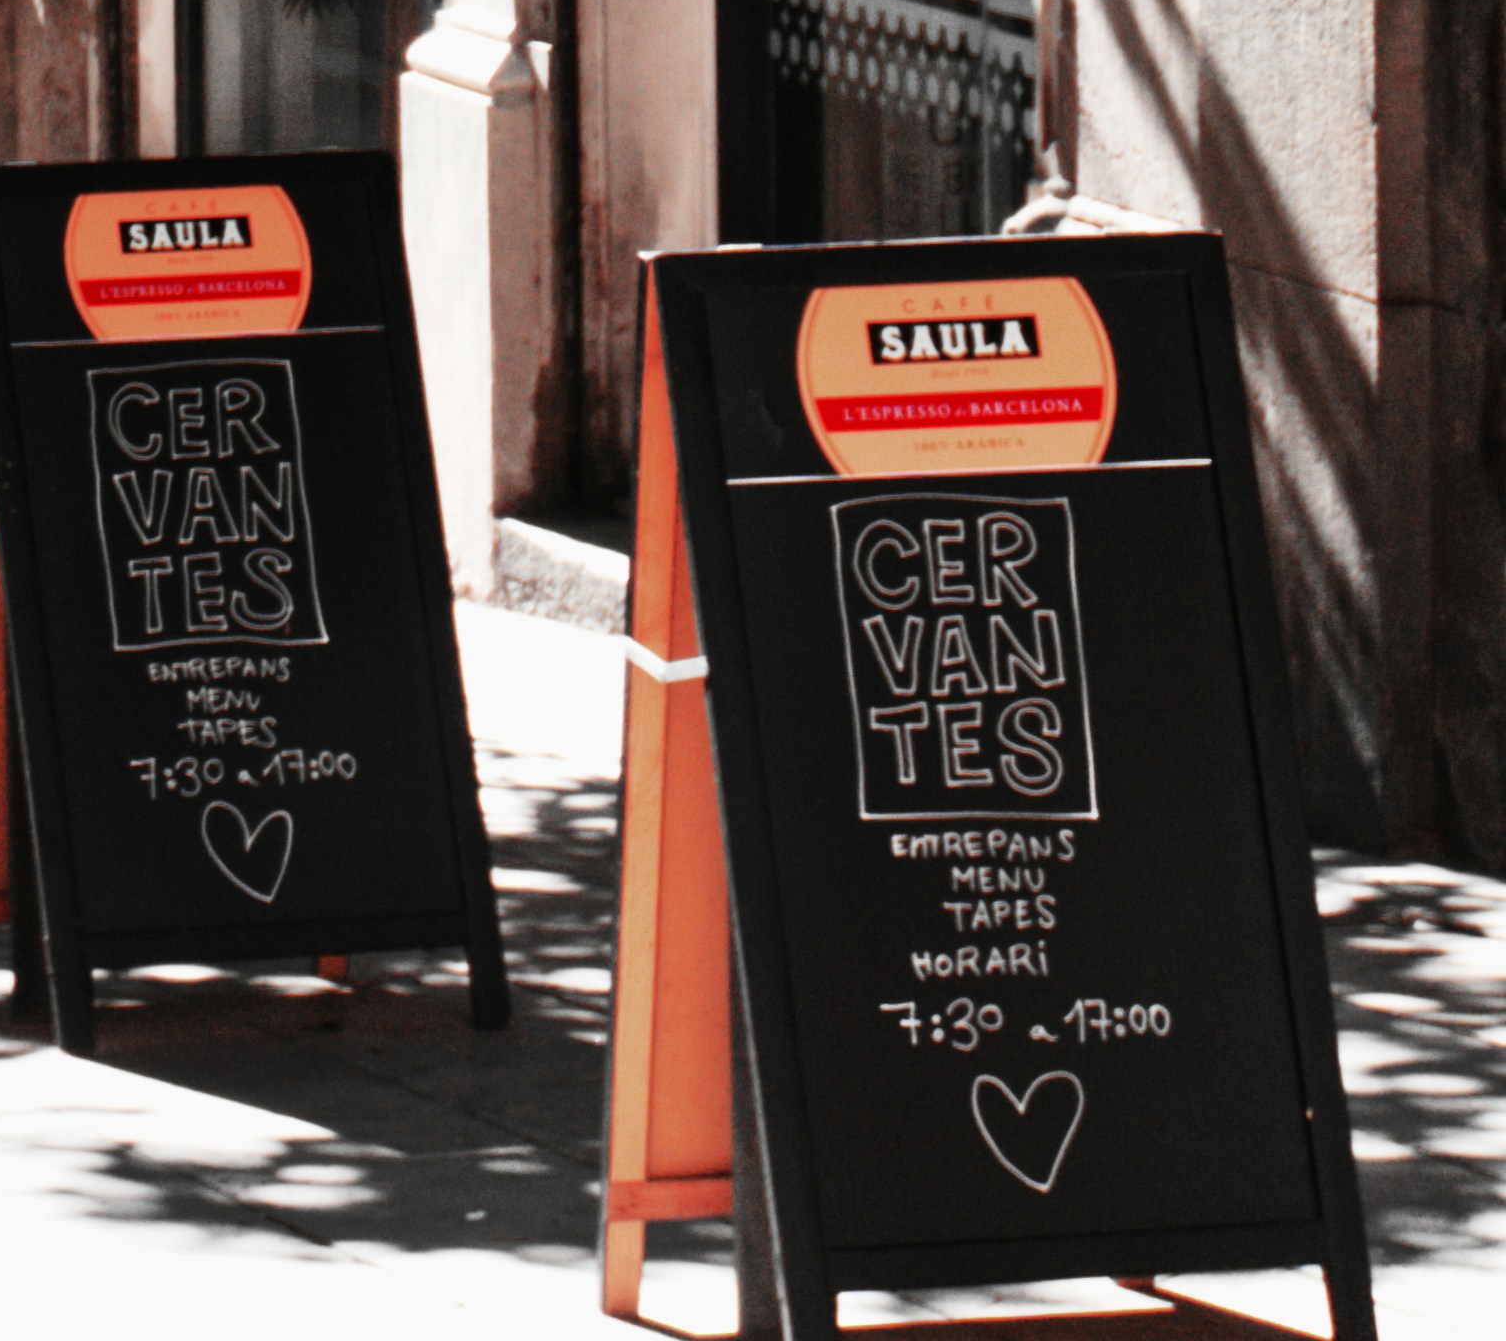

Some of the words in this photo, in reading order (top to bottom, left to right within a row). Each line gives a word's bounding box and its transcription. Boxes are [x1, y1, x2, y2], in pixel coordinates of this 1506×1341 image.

[130, 219, 244, 251] SAULA
[198, 278, 286, 293] BARCELONA
[881, 320, 1030, 362] SAULA
[108, 378, 280, 460] CER
[844, 403, 950, 422] L'ESPRESSO
[970, 398, 1083, 417] BARCELONA
[112, 462, 294, 544] VAN
[853, 511, 1038, 610] CER
[128, 548, 294, 633] TES
[147, 657, 290, 682] ENTREPANS
[862, 609, 1066, 696] VAN
[186, 686, 260, 714] MENU
[177, 716, 278, 747] TAPES
[869, 697, 1063, 797] TES
[130, 756, 224, 800] 7:30
[262, 749, 356, 786] 17:00
[890, 829, 1075, 861] ENTREPANS
[951, 866, 1045, 893] MENU
[943, 894, 1057, 931] TAPES
[879, 997, 1004, 1051] 7:30
[1063, 998, 1171, 1044] 17:00
